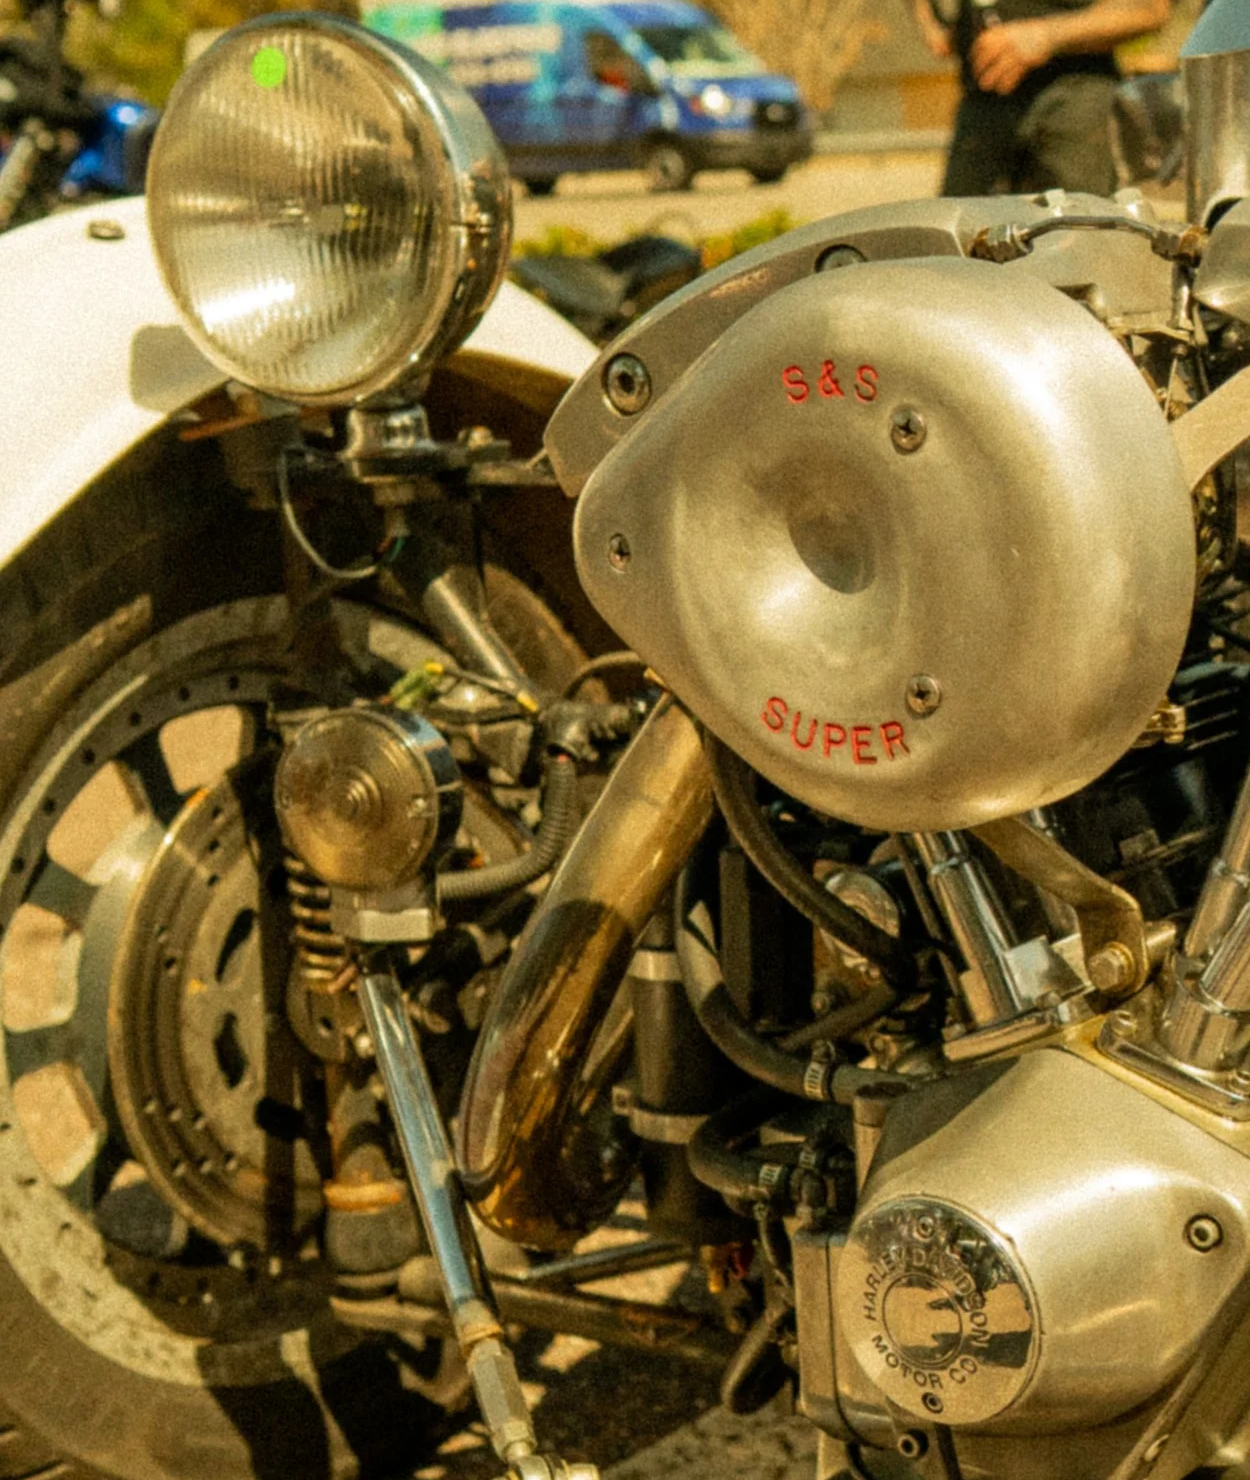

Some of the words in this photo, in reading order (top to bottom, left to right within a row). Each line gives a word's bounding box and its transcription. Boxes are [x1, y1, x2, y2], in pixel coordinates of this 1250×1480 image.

[782, 359, 879, 405] S&S
[762, 696, 911, 765] SUPER
[872, 1334, 944, 1390] MOTOR
